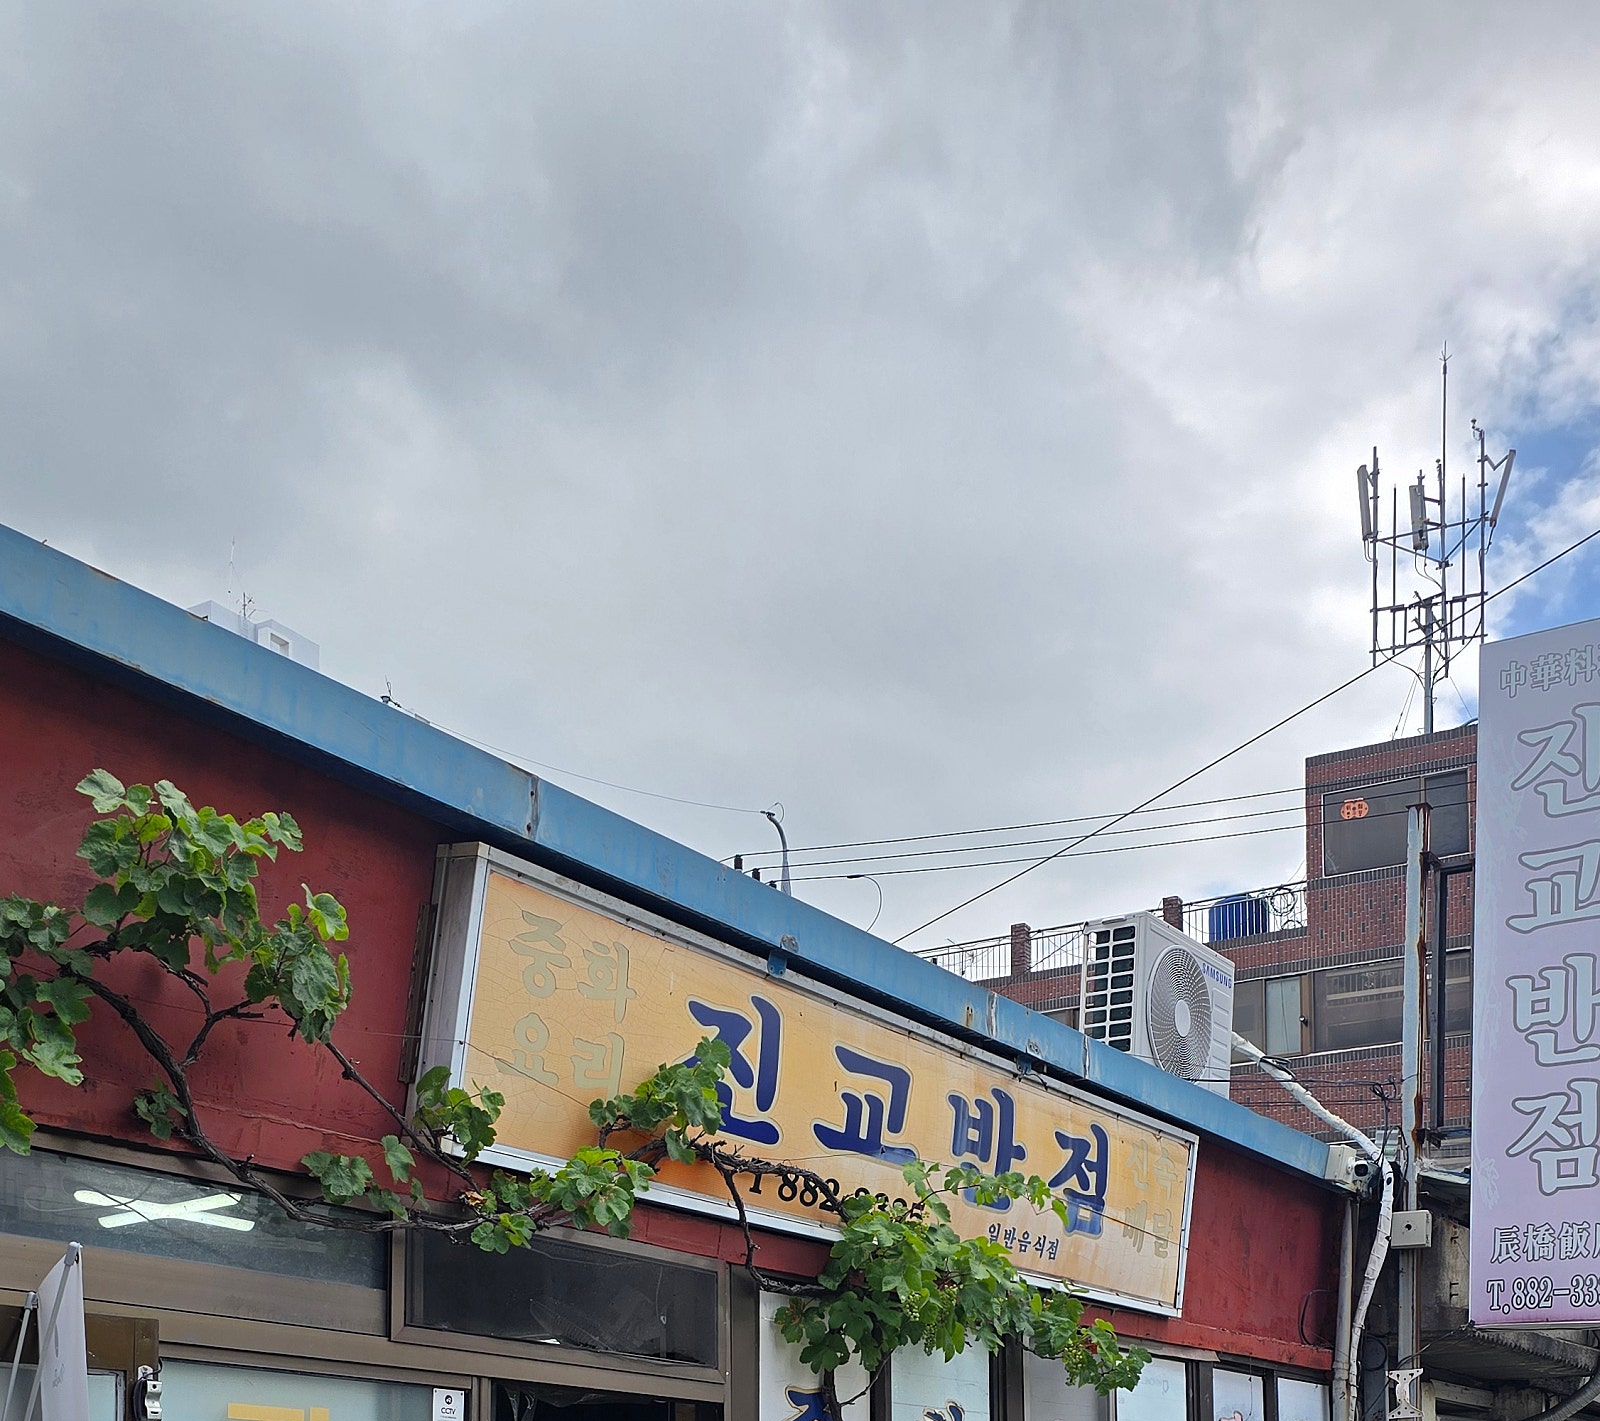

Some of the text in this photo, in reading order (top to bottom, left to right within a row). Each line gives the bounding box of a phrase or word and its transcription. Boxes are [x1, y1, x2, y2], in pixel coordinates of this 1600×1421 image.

[1500, 644, 1600, 698] 中華料
[508, 909, 637, 1024] 중화
[1202, 962, 1232, 989] SAMSUNG
[1505, 701, 1600, 1197] 진교반점
[494, 1011, 626, 1101] 요리
[682, 993, 1110, 1239] 진교반점
[1126, 1138, 1179, 1200] 신속
[988, 1222, 1059, 1260] 일반음식점
[1122, 1200, 1174, 1259] 배달
[1490, 1220, 1600, 1264] 辰橋飯
[440, 1407, 456, 1415] CCTV
